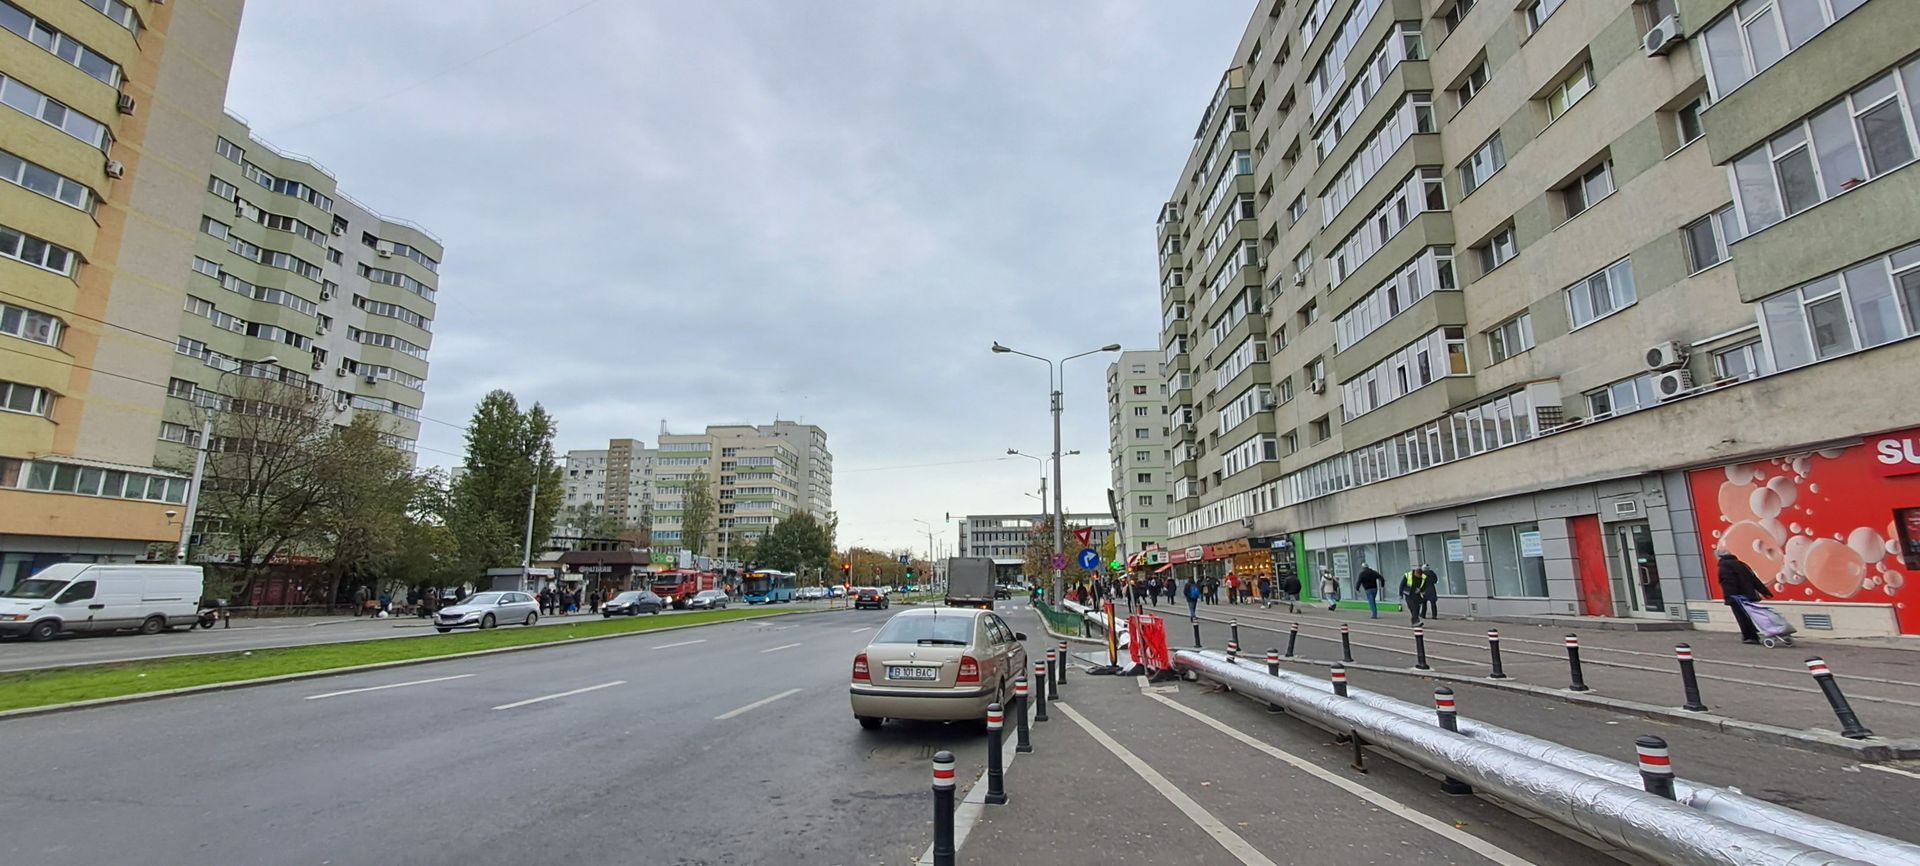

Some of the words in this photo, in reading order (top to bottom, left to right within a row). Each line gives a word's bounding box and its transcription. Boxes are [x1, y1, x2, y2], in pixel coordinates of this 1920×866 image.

[895, 667, 900, 676] B
[903, 668, 913, 676] 101
[916, 668, 932, 676] BAC
